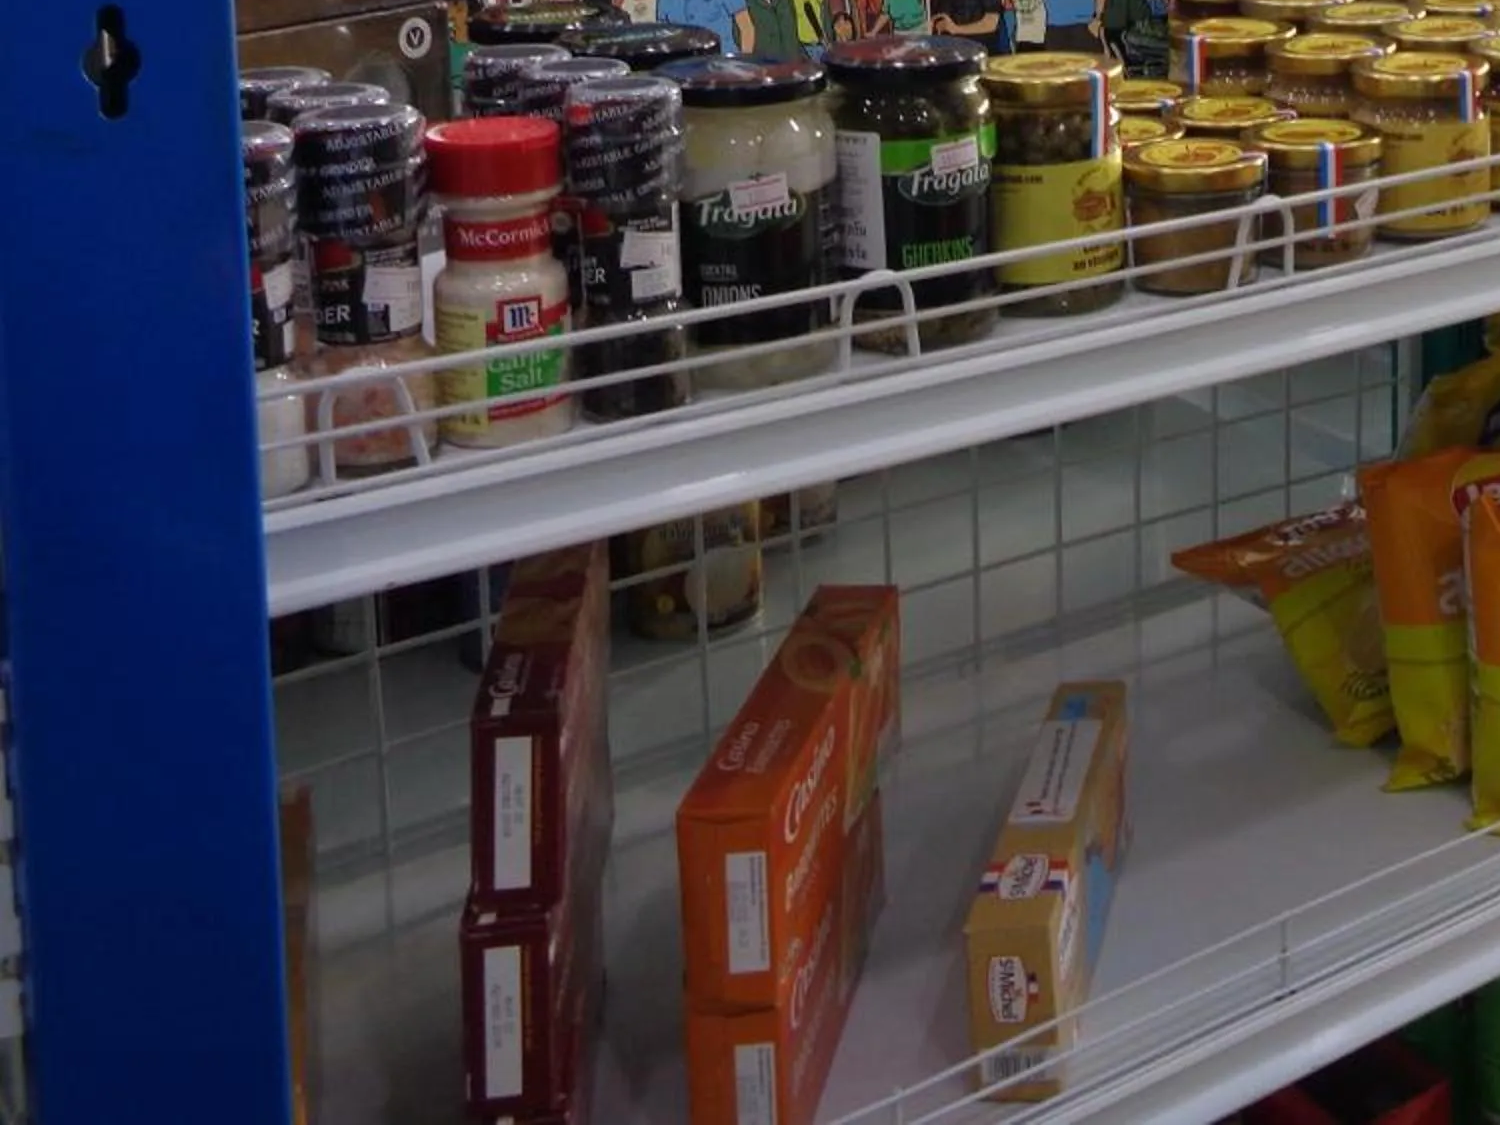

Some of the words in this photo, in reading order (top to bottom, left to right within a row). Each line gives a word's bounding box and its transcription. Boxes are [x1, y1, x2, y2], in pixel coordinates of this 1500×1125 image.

[901, 235, 974, 268] GHERKINS
[501, 367, 543, 391] Salt
[716, 720, 761, 773] Casino
